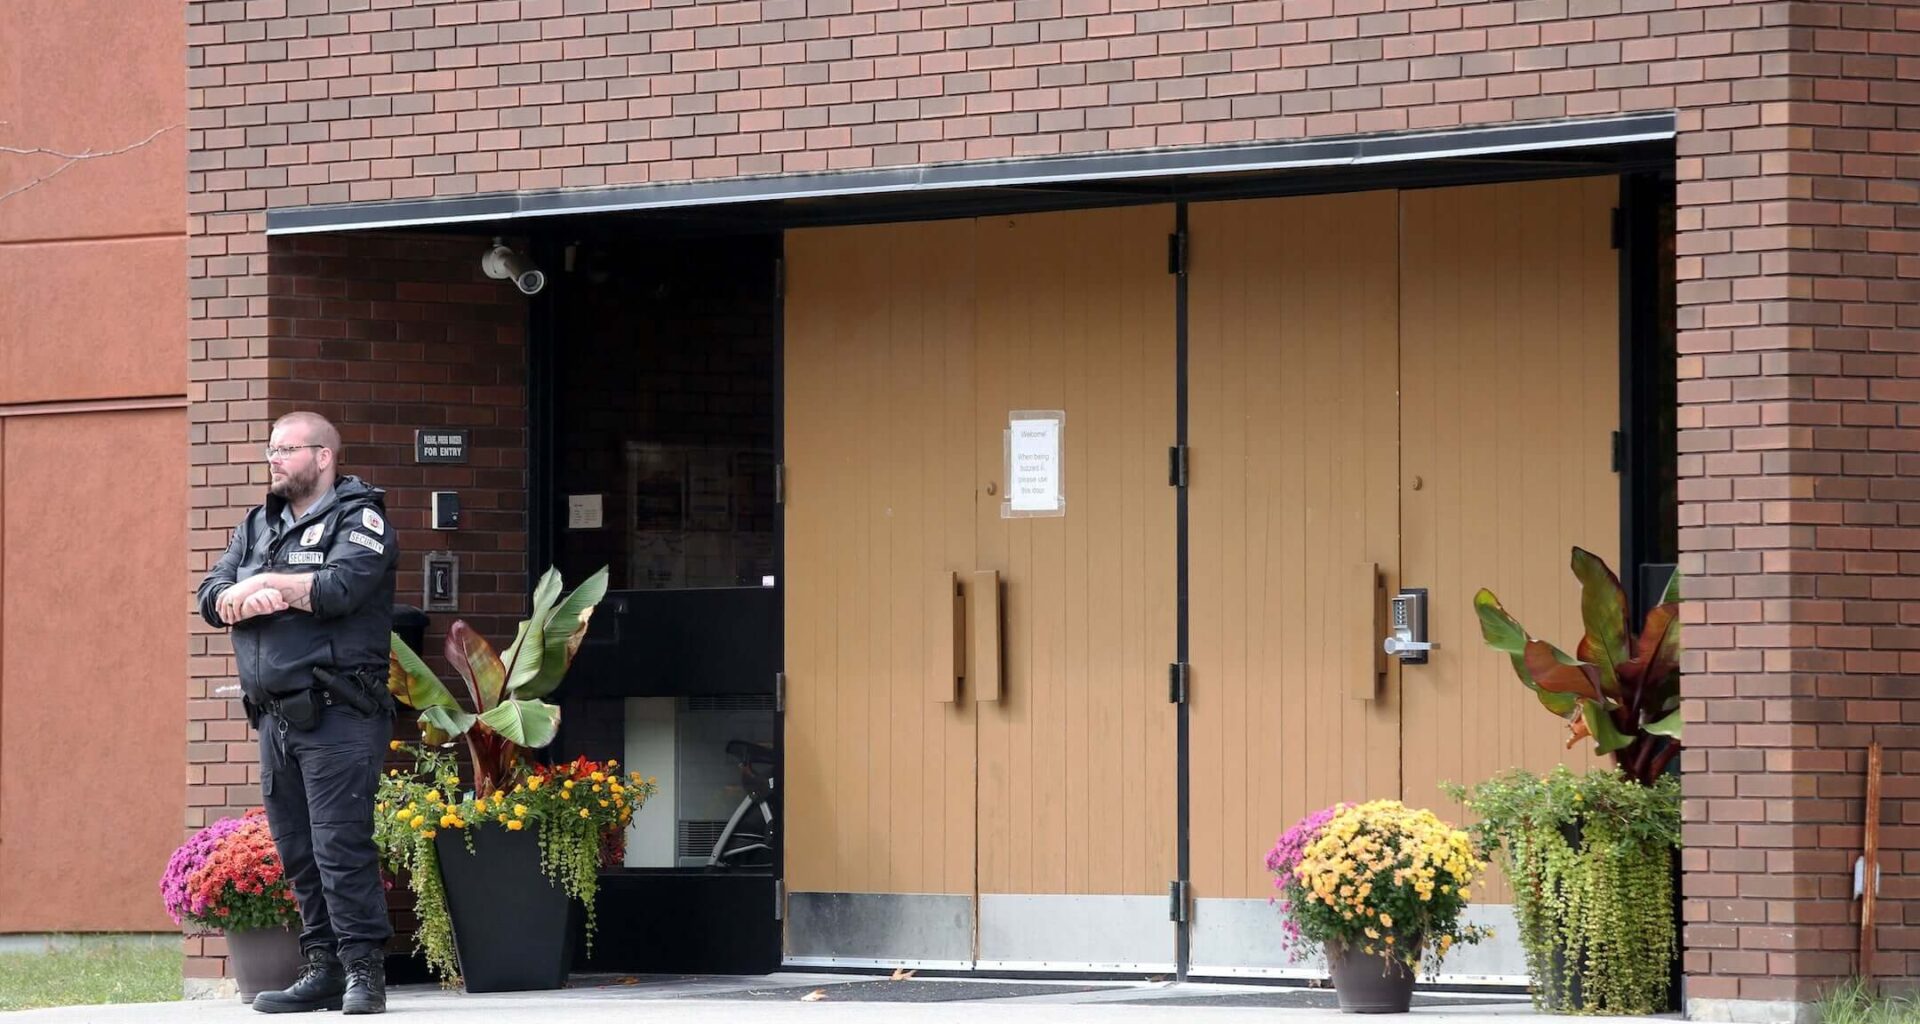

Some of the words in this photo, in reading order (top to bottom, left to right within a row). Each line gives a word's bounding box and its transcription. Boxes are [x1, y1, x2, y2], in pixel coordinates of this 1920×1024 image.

[424, 447, 437, 457] FOR
[440, 447, 461, 457] ENTRY
[351, 532, 382, 551] SECURITY
[289, 553, 322, 563] SECURITY
